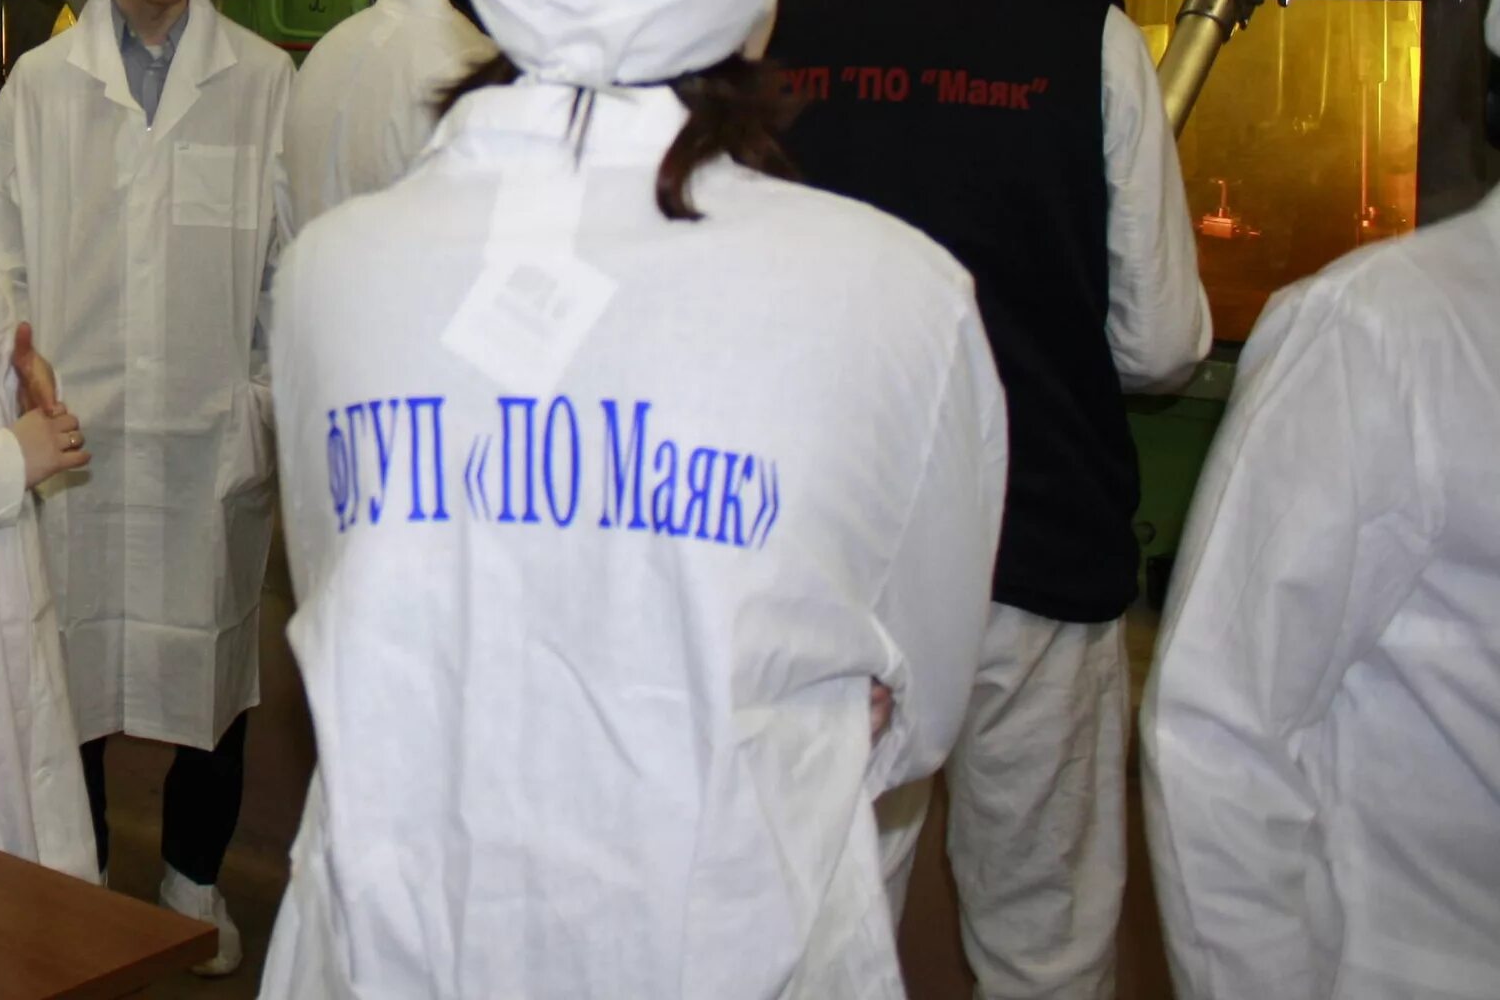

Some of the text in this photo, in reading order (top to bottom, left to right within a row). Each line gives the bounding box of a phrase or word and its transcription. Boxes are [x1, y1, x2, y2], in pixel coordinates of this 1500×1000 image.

[326, 394, 781, 551] ФГУП «ПО Маяк»
